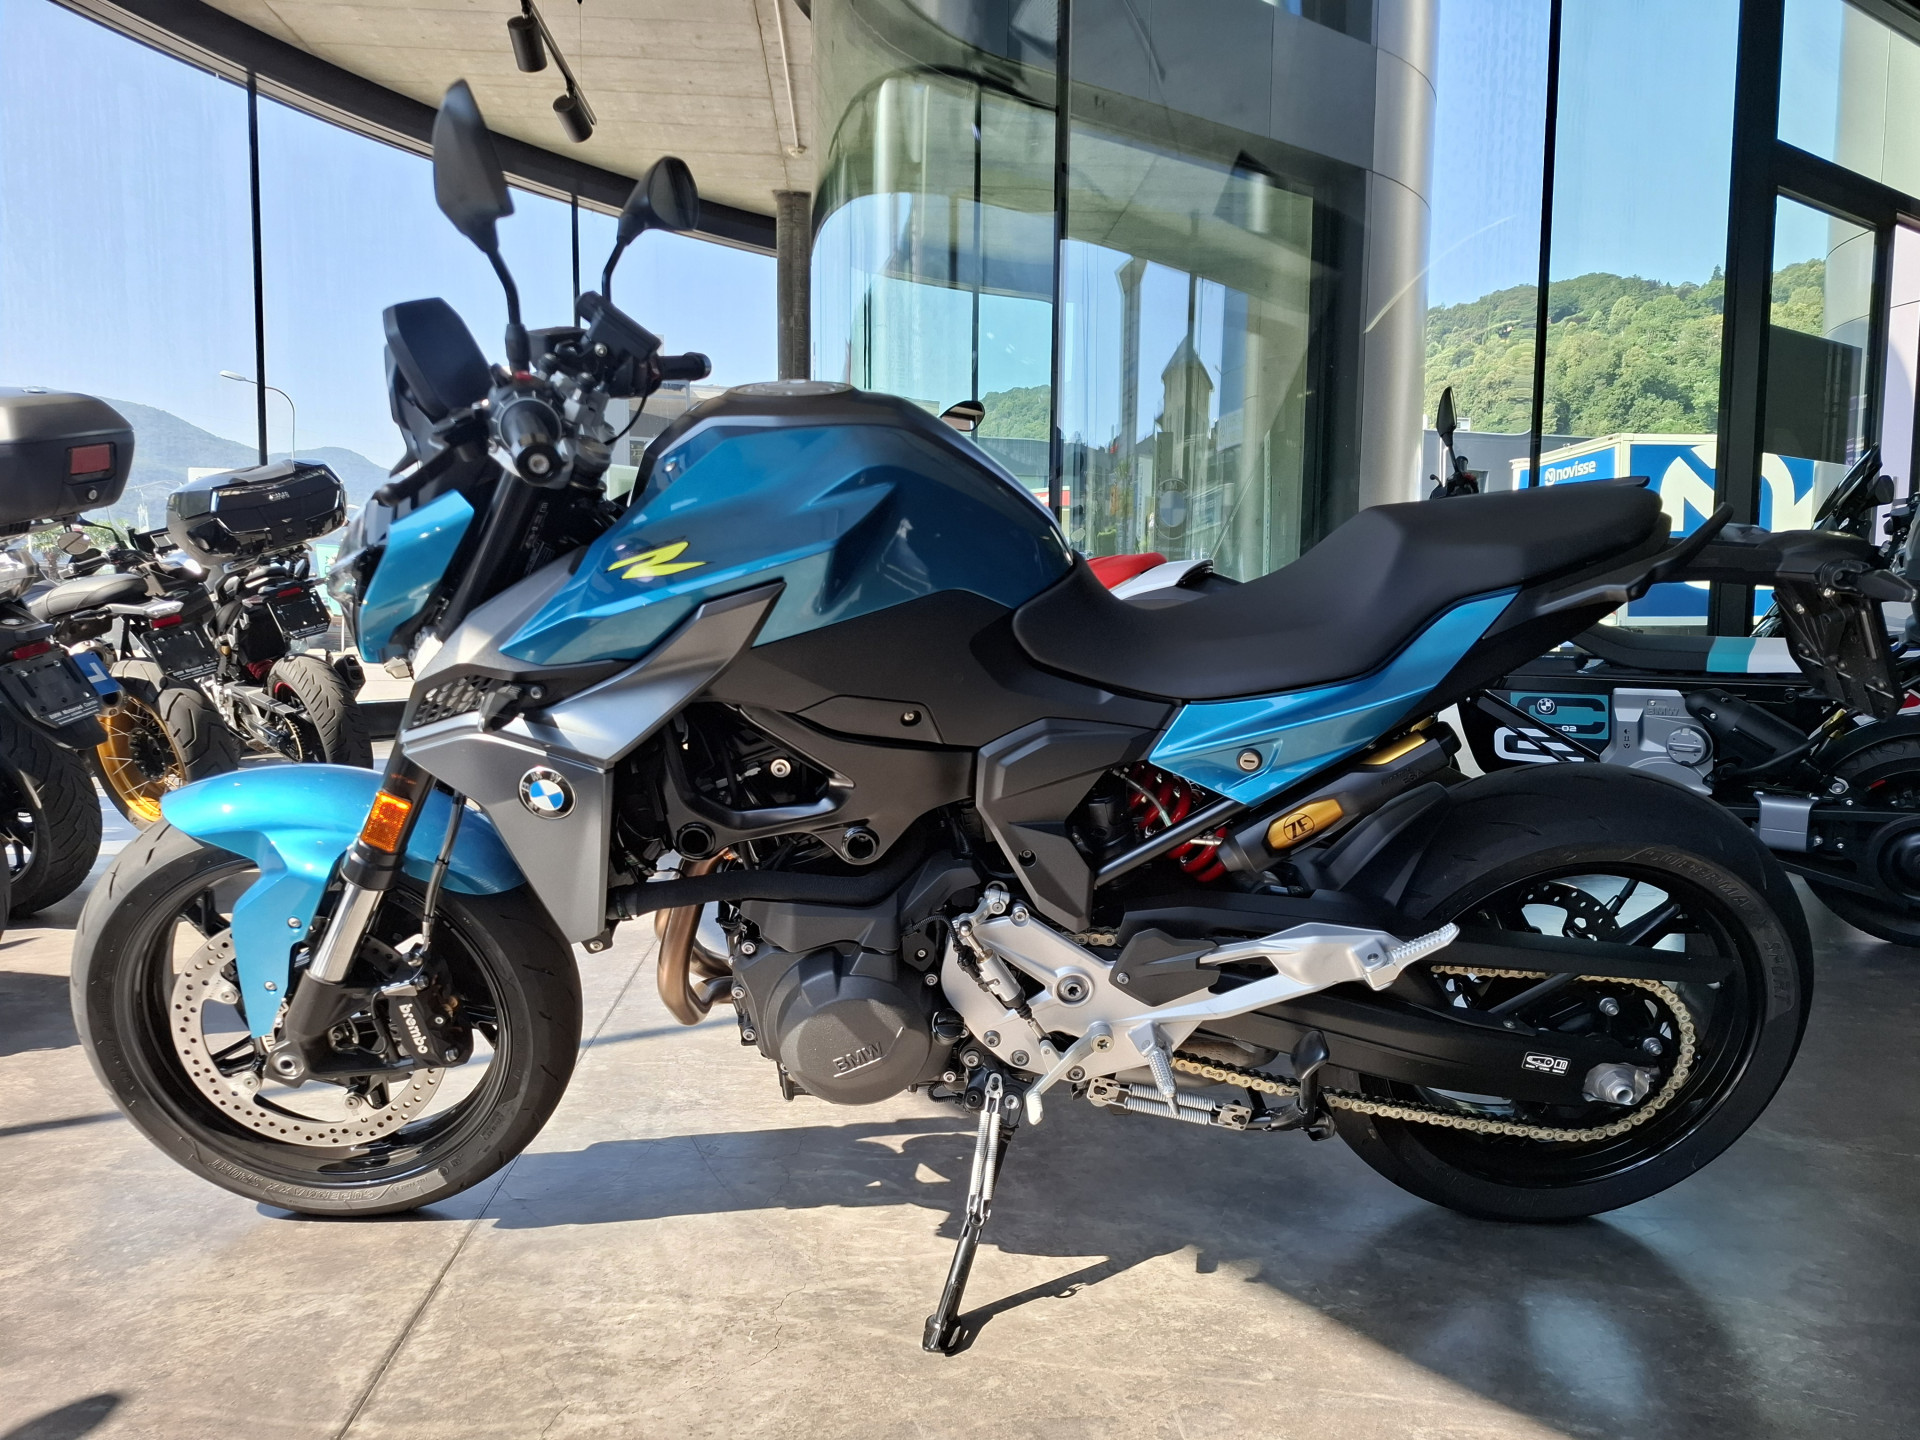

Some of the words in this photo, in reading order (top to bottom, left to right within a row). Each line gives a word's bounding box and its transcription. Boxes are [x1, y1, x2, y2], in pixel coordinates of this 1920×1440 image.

[1556, 460, 1597, 482] novisse
[1646, 707, 1680, 717] BMW
[398, 1003, 429, 1054] brembo
[832, 1041, 884, 1073] BMW
